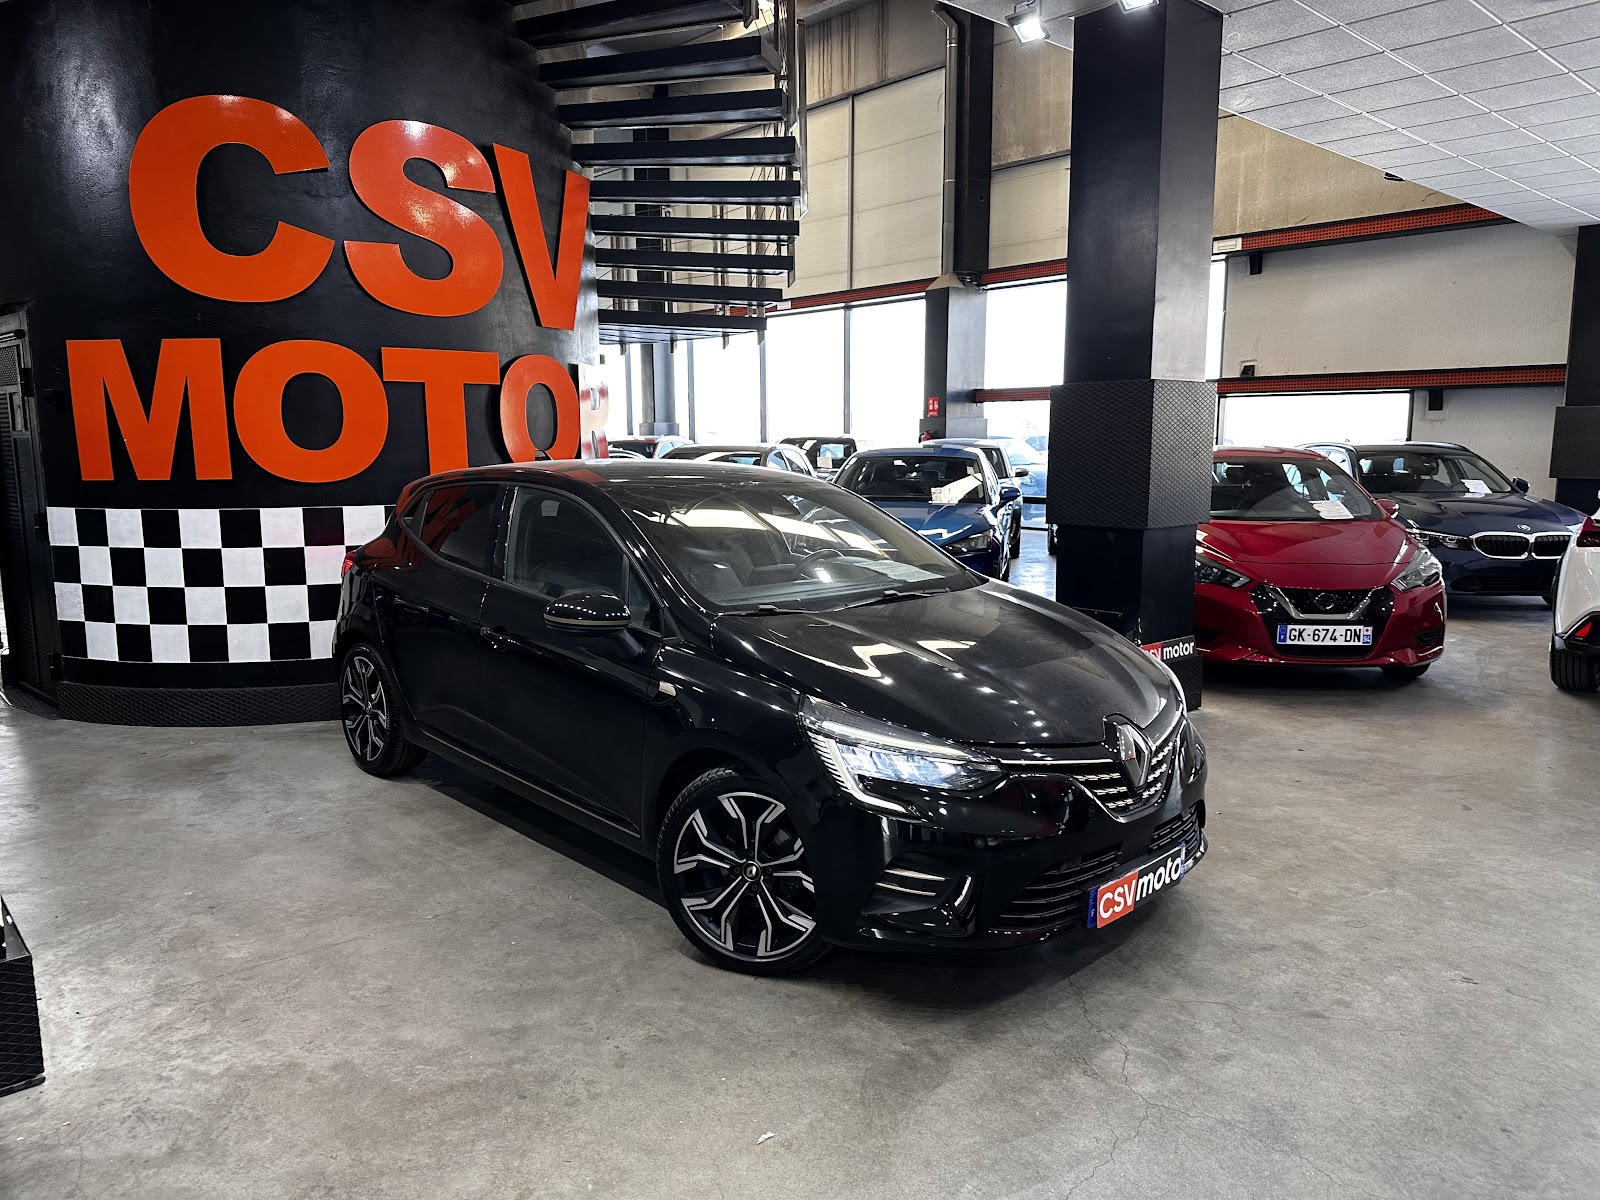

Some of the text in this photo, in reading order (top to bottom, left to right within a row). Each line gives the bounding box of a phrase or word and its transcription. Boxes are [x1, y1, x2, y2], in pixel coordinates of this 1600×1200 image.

[129, 94, 591, 331] CSV
[66, 337, 609, 483] MOTOR
[1163, 641, 1195, 660] motor
[1288, 628, 1362, 643] GK-674-DN
